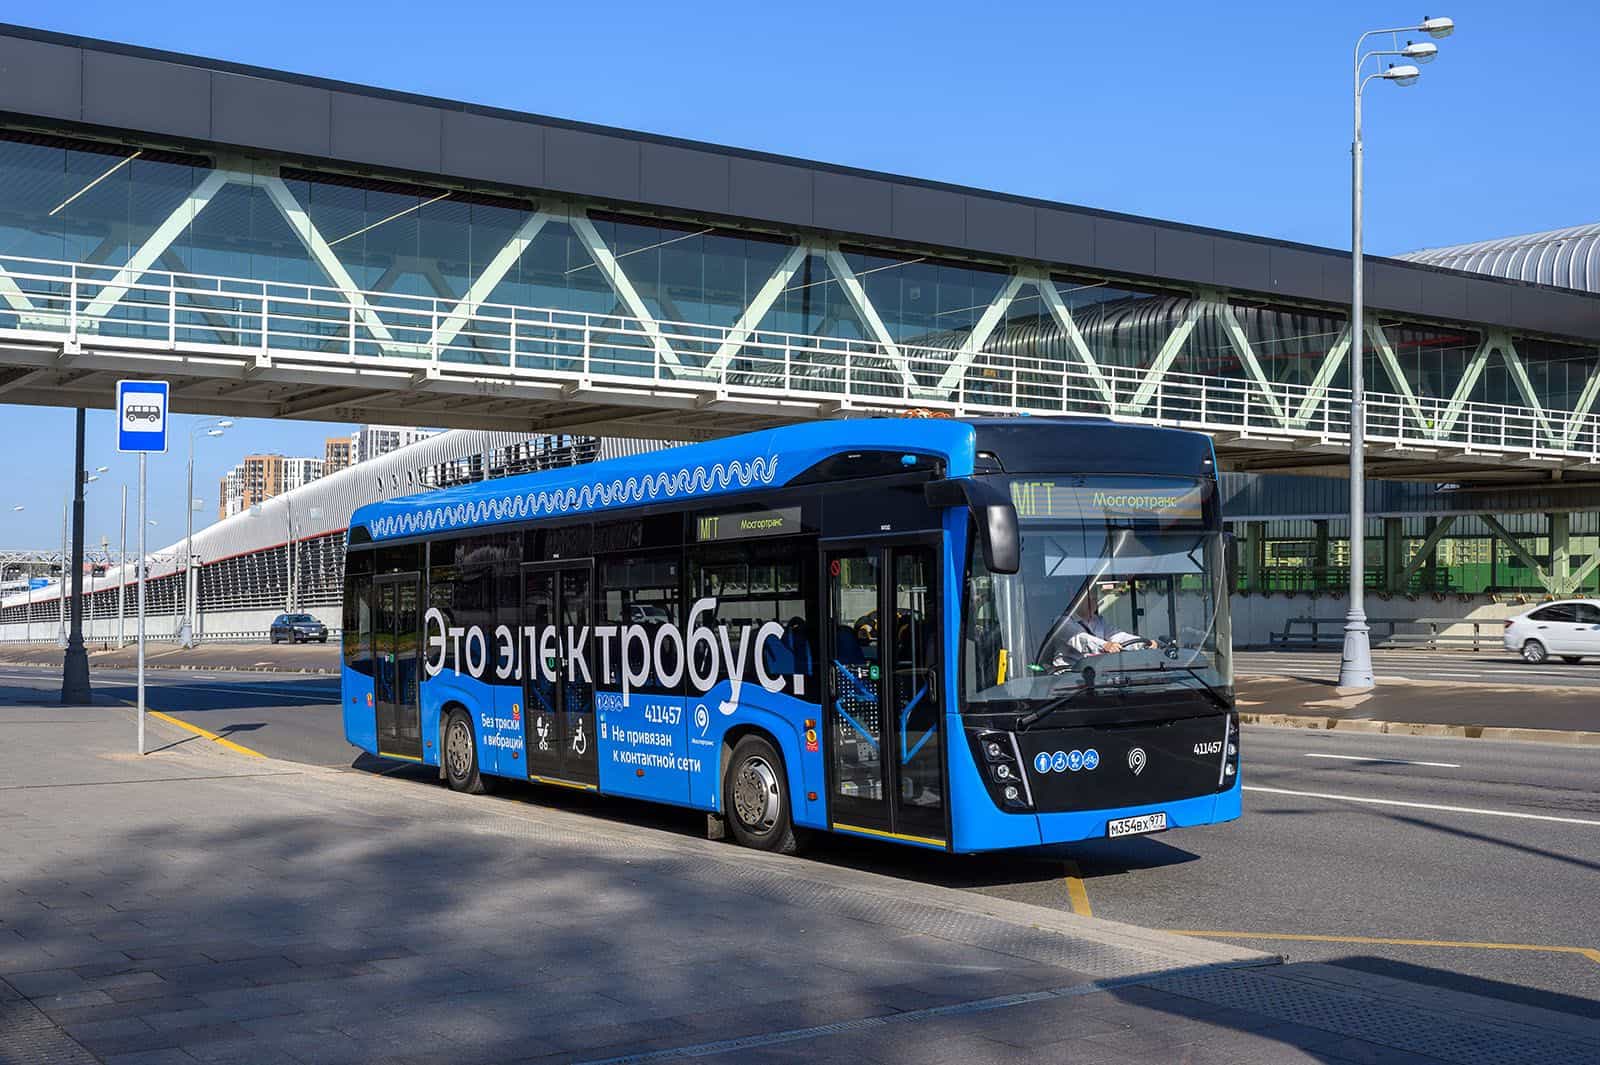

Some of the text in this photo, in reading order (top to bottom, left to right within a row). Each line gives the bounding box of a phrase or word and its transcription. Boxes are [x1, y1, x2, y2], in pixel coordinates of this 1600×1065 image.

[1011, 482, 1177, 516] МГТ Мосгортранс
[700, 517, 720, 540] МГТ
[424, 597, 805, 715] Это электробус.
[481, 713, 520, 731] Без тряски
[644, 704, 682, 725] 411457
[488, 732, 523, 751] вибраций
[611, 726, 625, 742] Не
[626, 731, 672, 747] привязан
[1193, 741, 1222, 756] 411457
[612, 750, 701, 773] к контактной сети
[1111, 814, 1164, 835] М354ВХ 977
